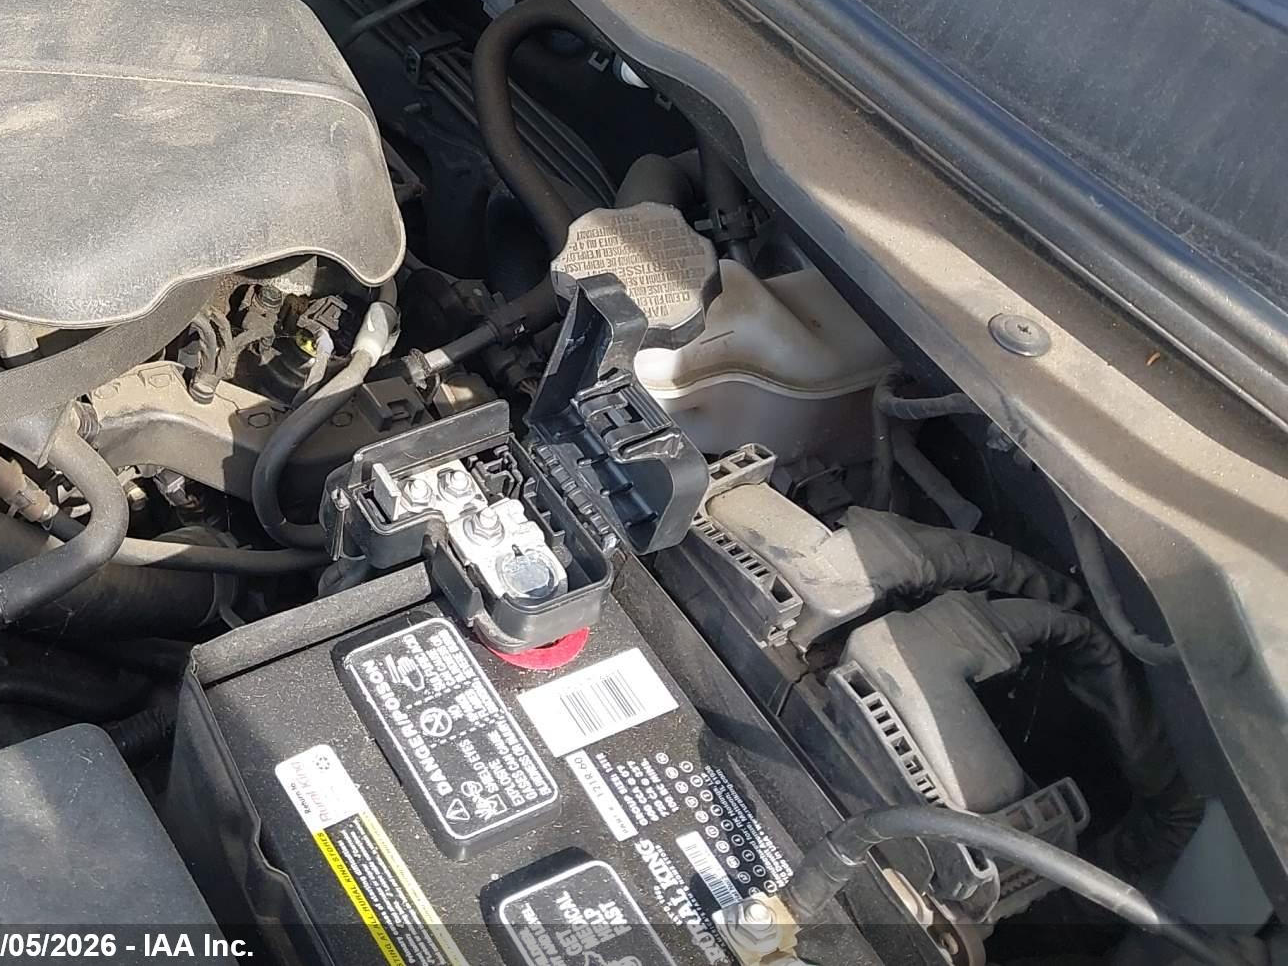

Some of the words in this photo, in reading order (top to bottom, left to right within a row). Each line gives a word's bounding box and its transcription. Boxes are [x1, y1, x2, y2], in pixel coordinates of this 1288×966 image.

[359, 659, 454, 795] DANGER/POISON
[458, 738, 480, 762] EYES
[501, 750, 520, 770] CAN
[488, 758, 525, 805] EXPLOSIVE
[512, 769, 538, 800] GASES
[573, 755, 604, 797] 121R-60
[293, 791, 312, 814] Return
[305, 790, 333, 822] Rural
[631, 785, 648, 804] CCA
[644, 785, 658, 800] CA
[622, 793, 649, 827] GROUP
[316, 831, 340, 863] STORES
[632, 836, 678, 890] KING
[335, 862, 353, 884] KING
[357, 875, 380, 903] starting
[348, 883, 370, 912] RURAL
[518, 902, 546, 935] LEVEL.
[553, 891, 600, 949] MEDICAL
[582, 904, 615, 942] HELP
[598, 897, 632, 935] FAST
[666, 888, 727, 964] RURAL
[376, 930, 388, 942] AT
[395, 935, 417, 963] Primary
[554, 925, 583, 957] GET
